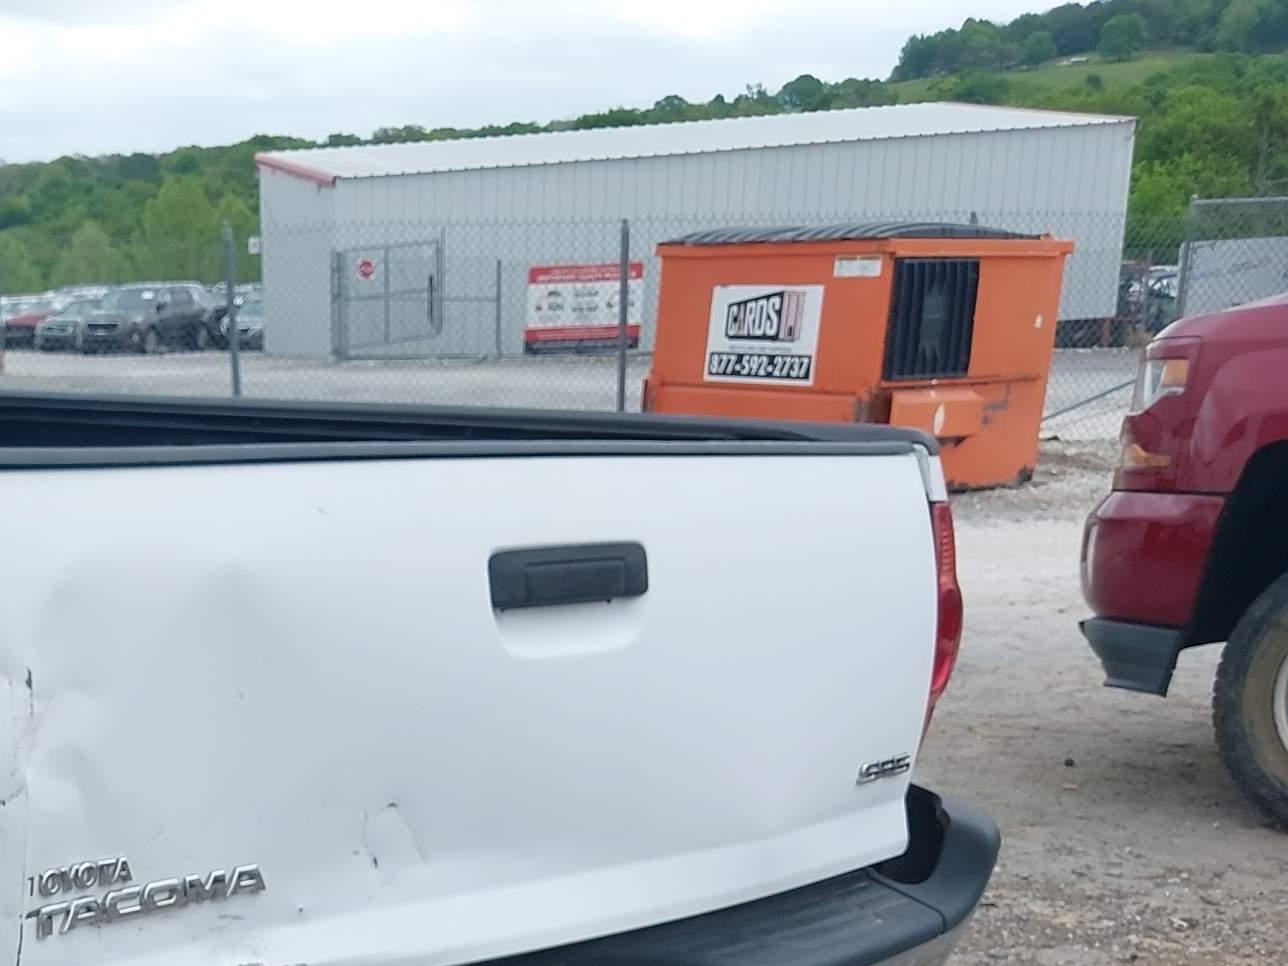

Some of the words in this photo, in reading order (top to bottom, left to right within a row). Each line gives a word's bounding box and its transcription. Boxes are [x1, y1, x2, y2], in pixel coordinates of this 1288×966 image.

[727, 294, 781, 337] CARDS
[26, 856, 134, 897] TOYOTA
[24, 863, 267, 940] TACOMA
